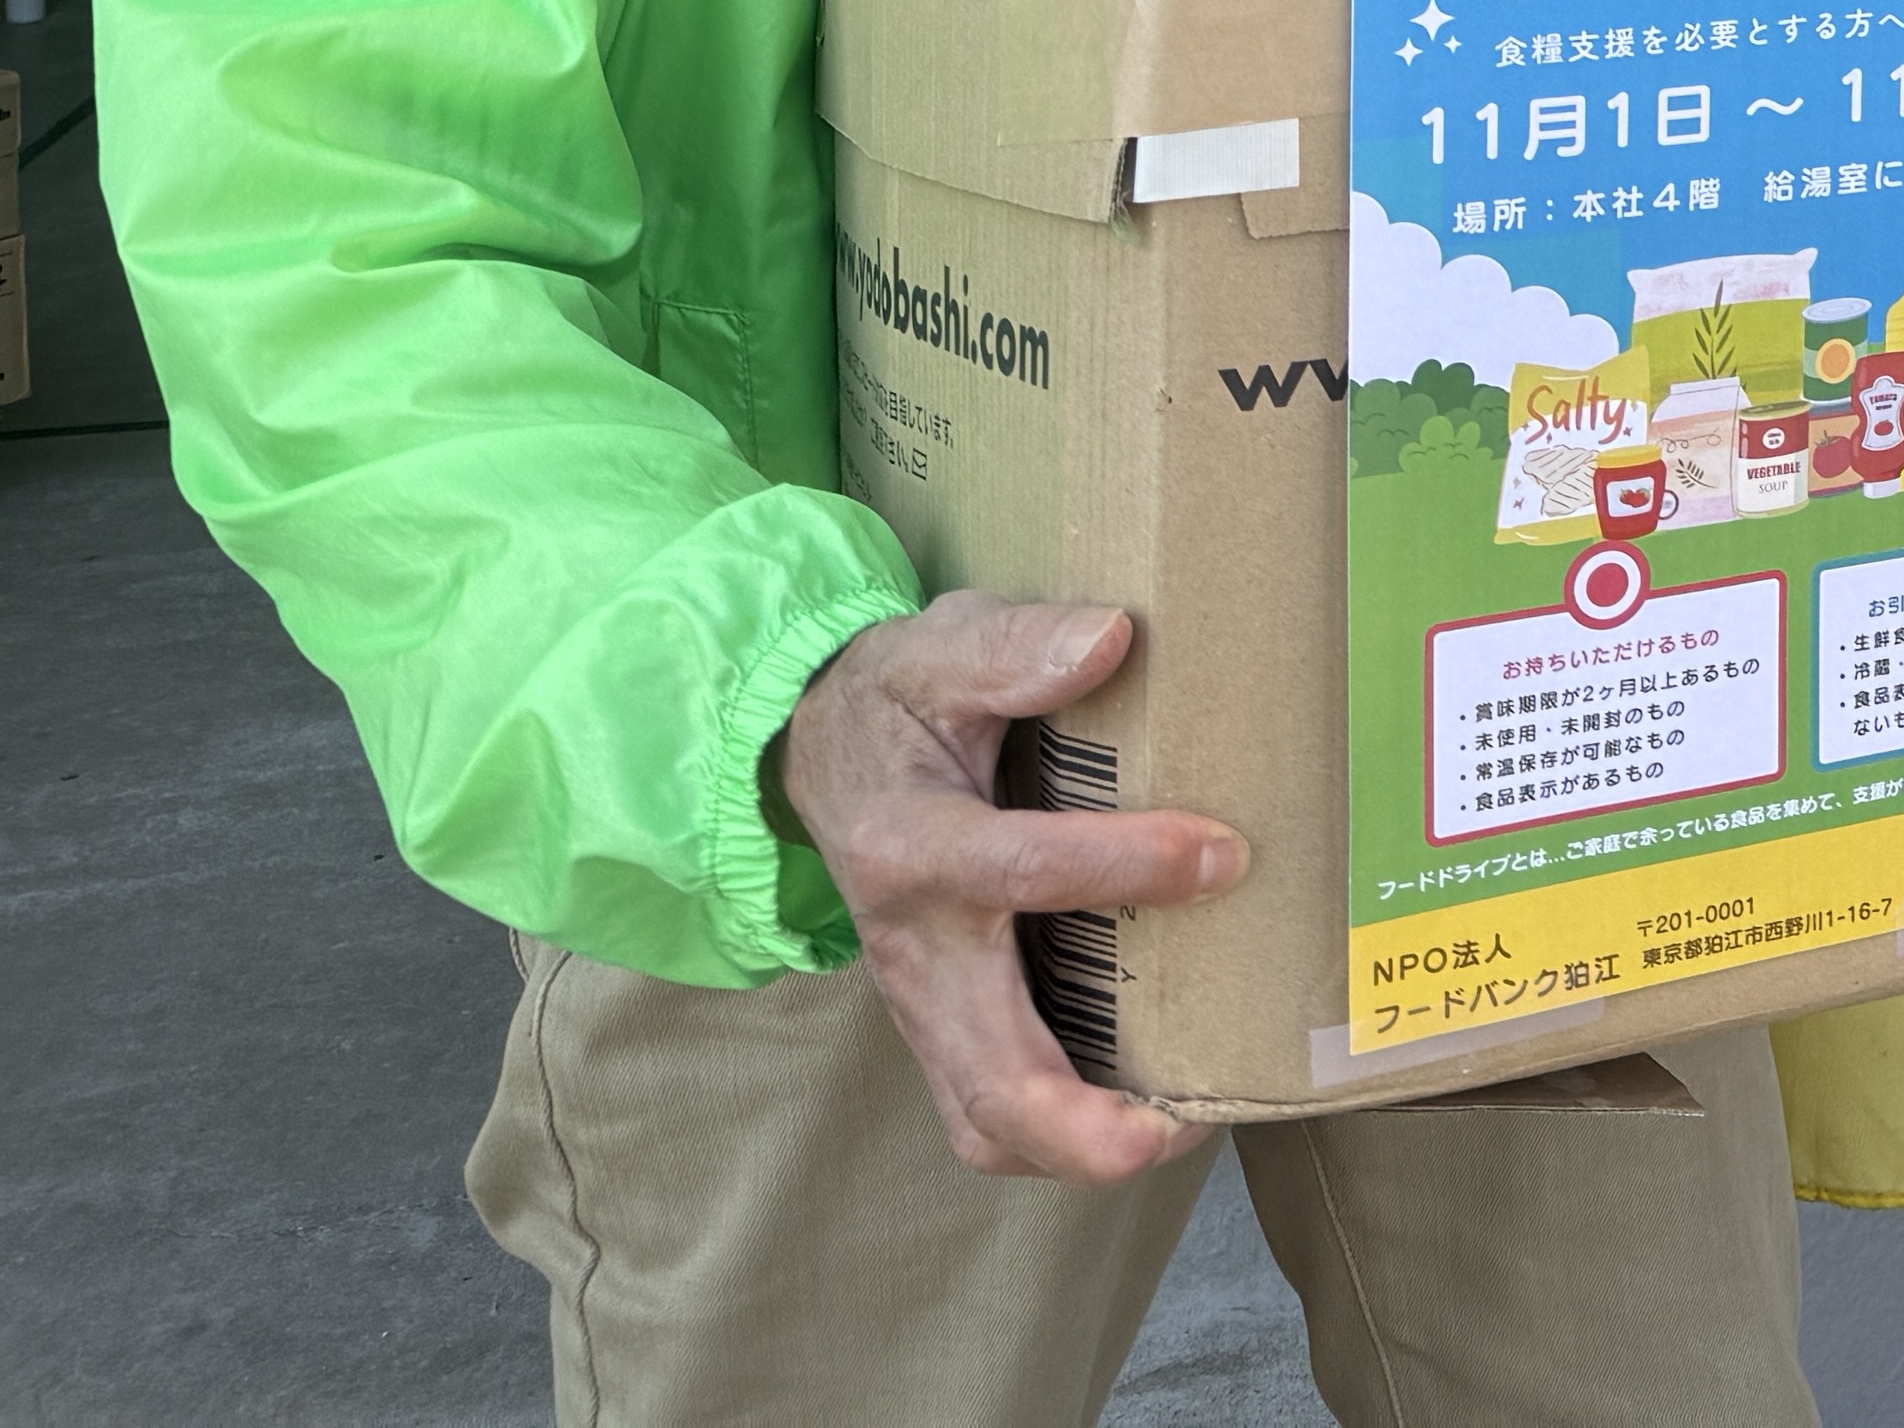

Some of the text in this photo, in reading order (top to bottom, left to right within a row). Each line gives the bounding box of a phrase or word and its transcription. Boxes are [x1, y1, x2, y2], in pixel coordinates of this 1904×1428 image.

[1420, 84, 1711, 165] 11月1日
[1525, 383, 1628, 445] Salty
[1746, 461, 1801, 481] VEGETABLE
[1758, 479, 1789, 494] SOUP
[1501, 629, 1720, 681] お持ちいただけるもの
[1474, 729, 1686, 782] 常温保存が可能なもの
[1474, 761, 1665, 813] 食品表示があるもの
[1372, 932, 1513, 987] NPO法人
[1374, 953, 1622, 1034] フードバンク狛江
